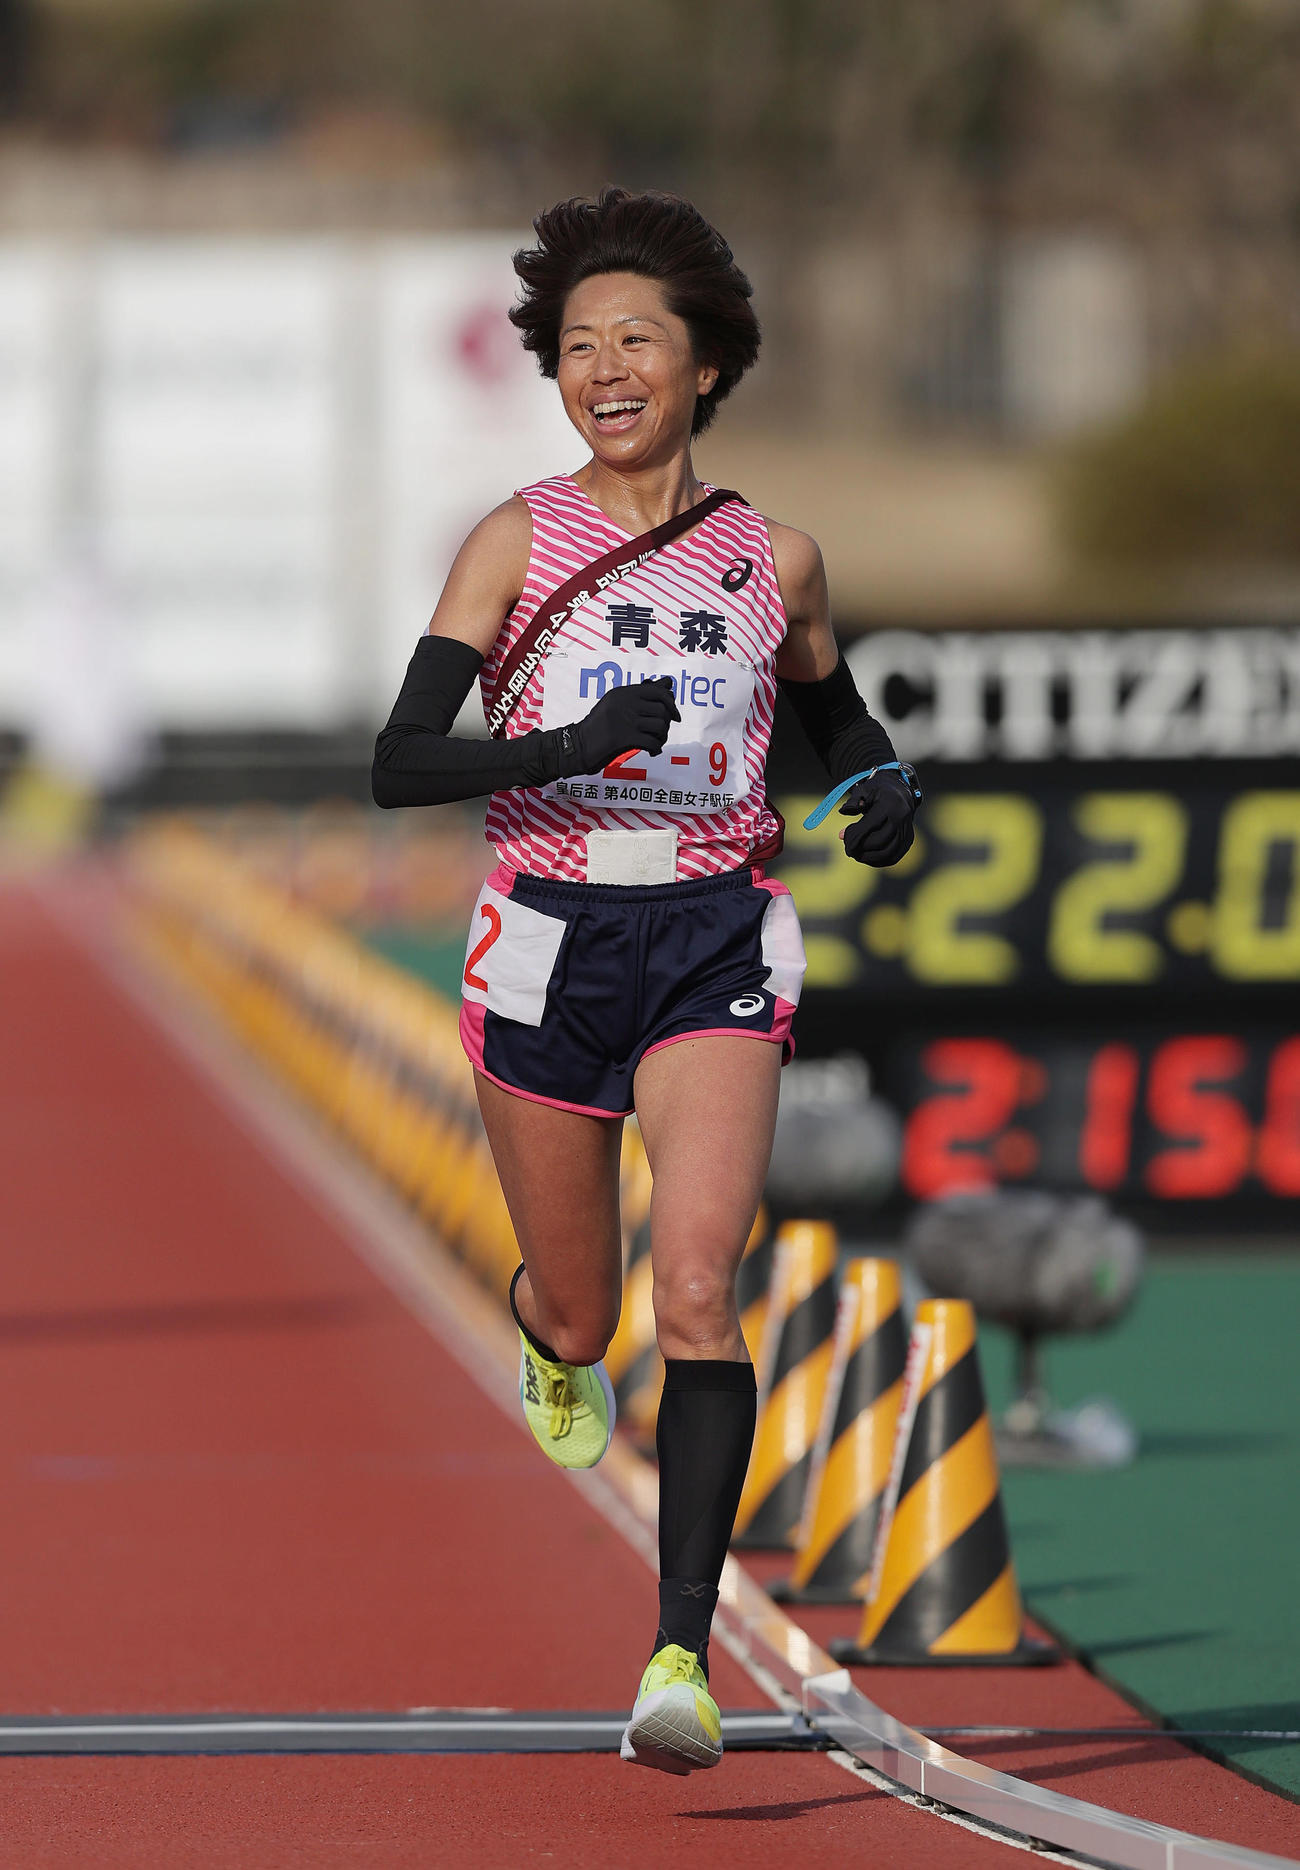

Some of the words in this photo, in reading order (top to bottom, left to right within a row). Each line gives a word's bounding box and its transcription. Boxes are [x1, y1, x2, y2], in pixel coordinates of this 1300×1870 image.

[605, 603, 728, 655] 青森
[843, 627, 1300, 760] CITIZE
[556, 782, 599, 800] 皇后盃
[604, 785, 735, 808] 第40回全国女子駅伝
[463, 903, 502, 994] 2
